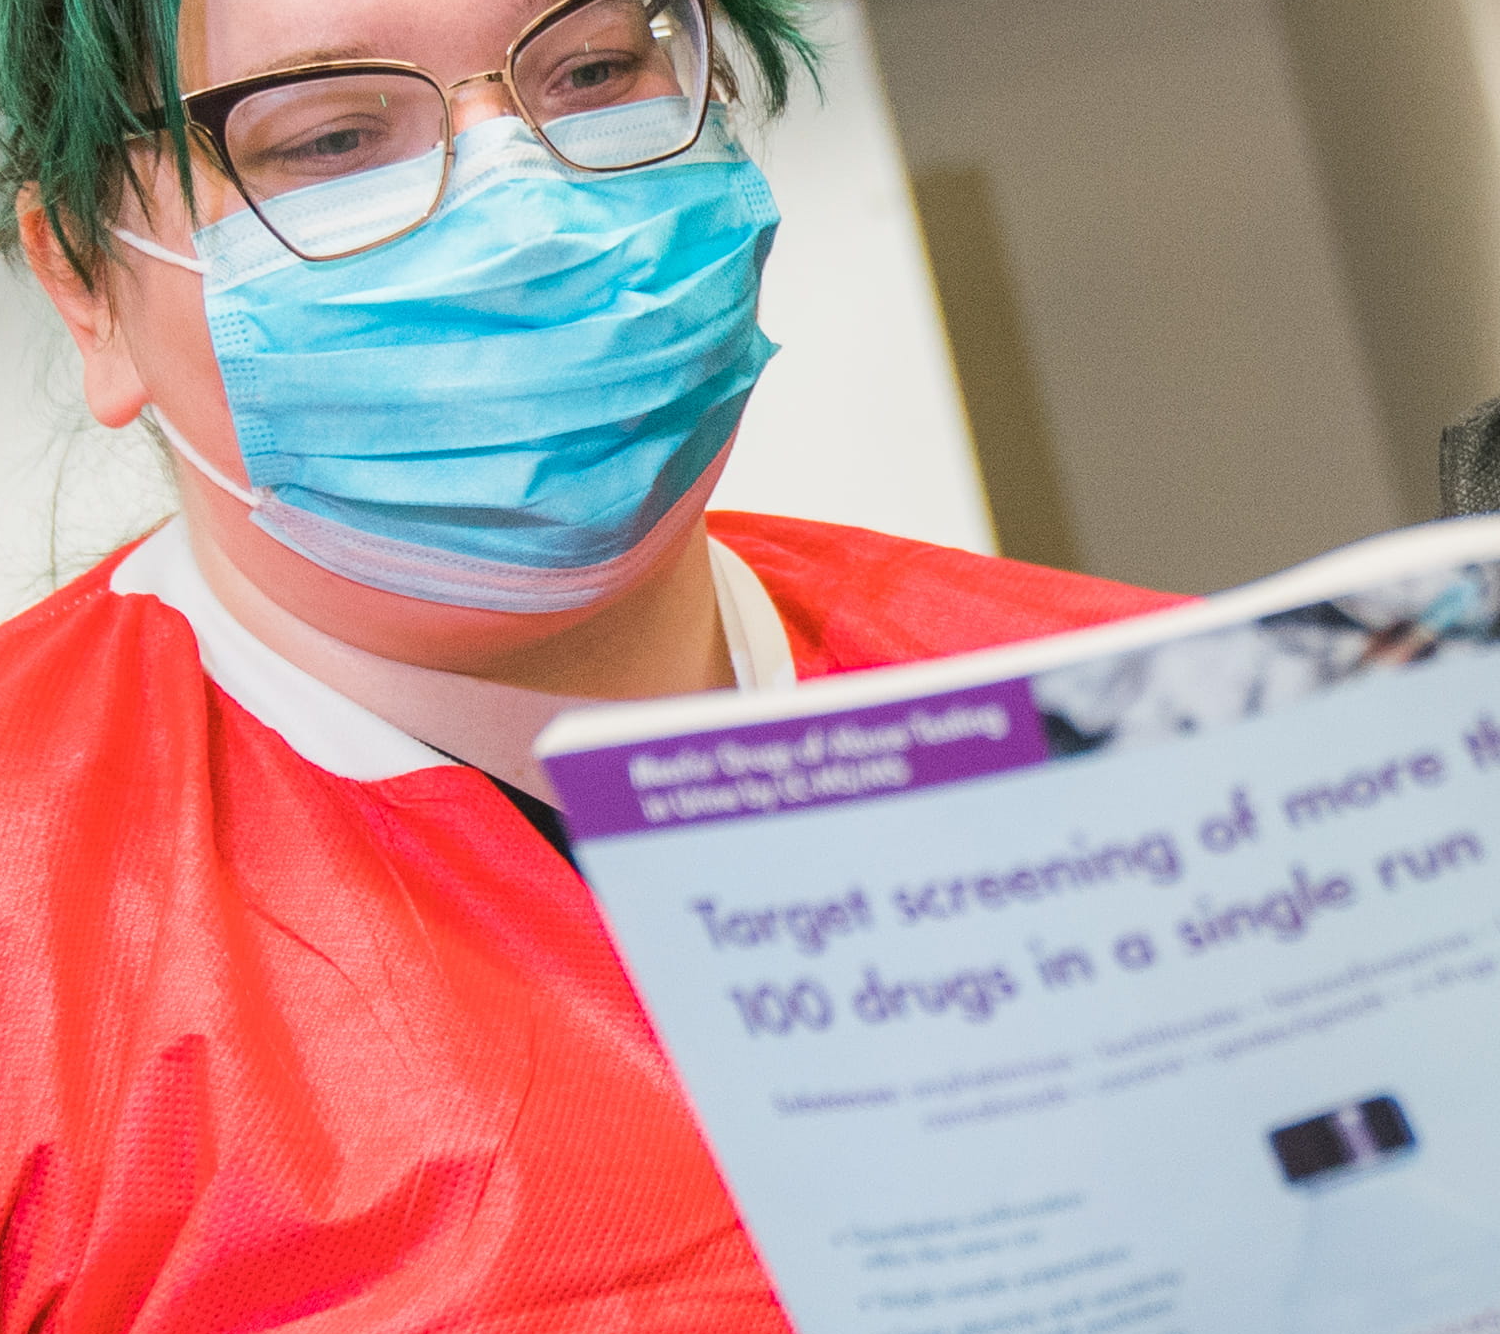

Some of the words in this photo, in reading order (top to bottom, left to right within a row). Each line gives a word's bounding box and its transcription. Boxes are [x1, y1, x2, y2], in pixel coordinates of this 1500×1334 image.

[690, 886, 874, 954] Target
[892, 830, 1183, 927] screening
[1197, 786, 1260, 854] of
[1280, 749, 1447, 827] more
[730, 976, 835, 1037] 100
[851, 960, 1019, 1030] drugs
[1035, 937, 1097, 990] in
[1111, 931, 1159, 972] a
[1175, 865, 1357, 955] single
[1375, 827, 1485, 891] run
